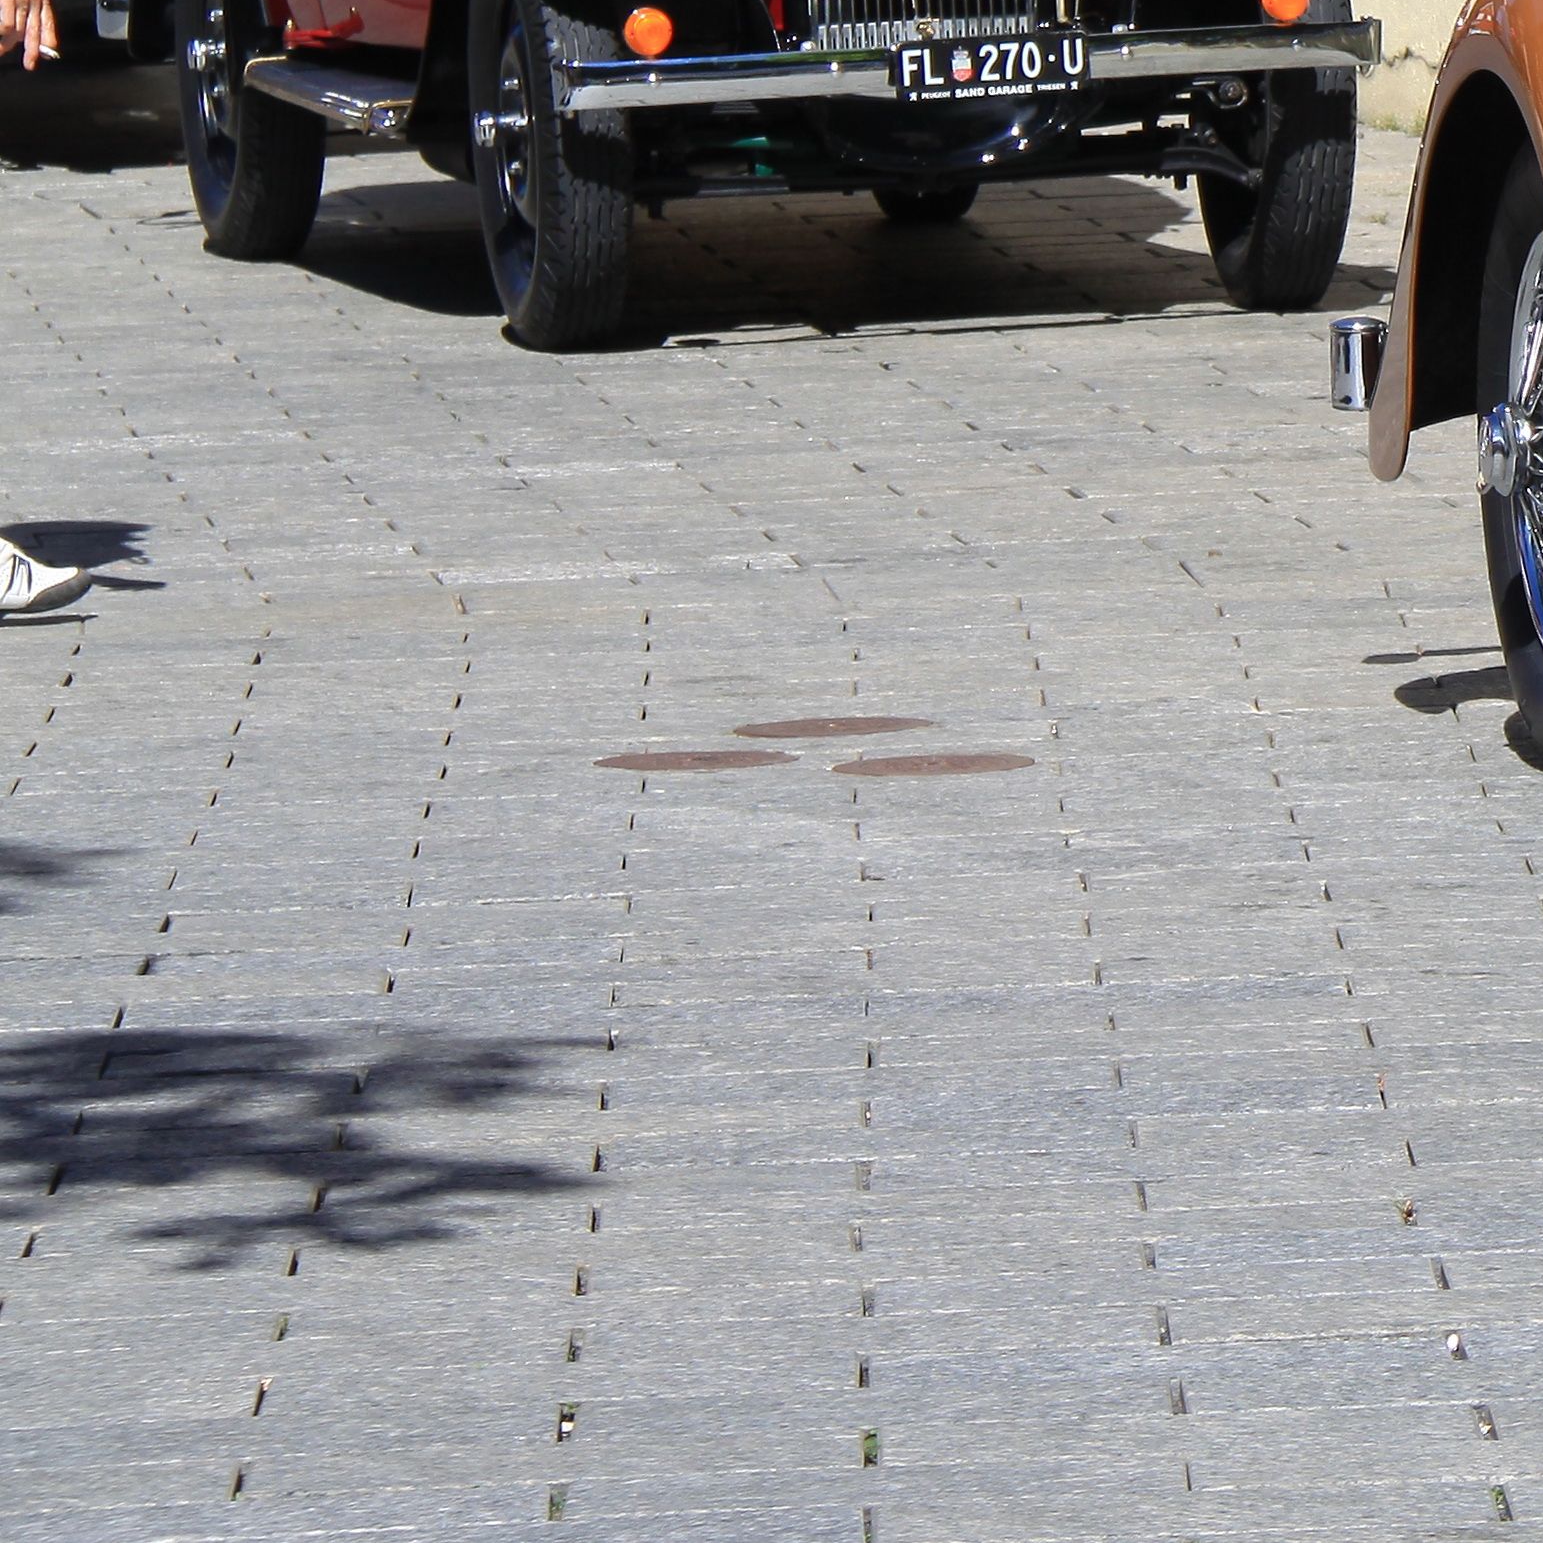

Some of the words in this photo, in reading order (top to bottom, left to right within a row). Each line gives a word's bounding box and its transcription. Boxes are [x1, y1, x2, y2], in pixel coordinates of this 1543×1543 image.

[901, 49, 945, 87] FL
[955, 87, 985, 99] SAND
[988, 84, 1033, 97] GARAGE
